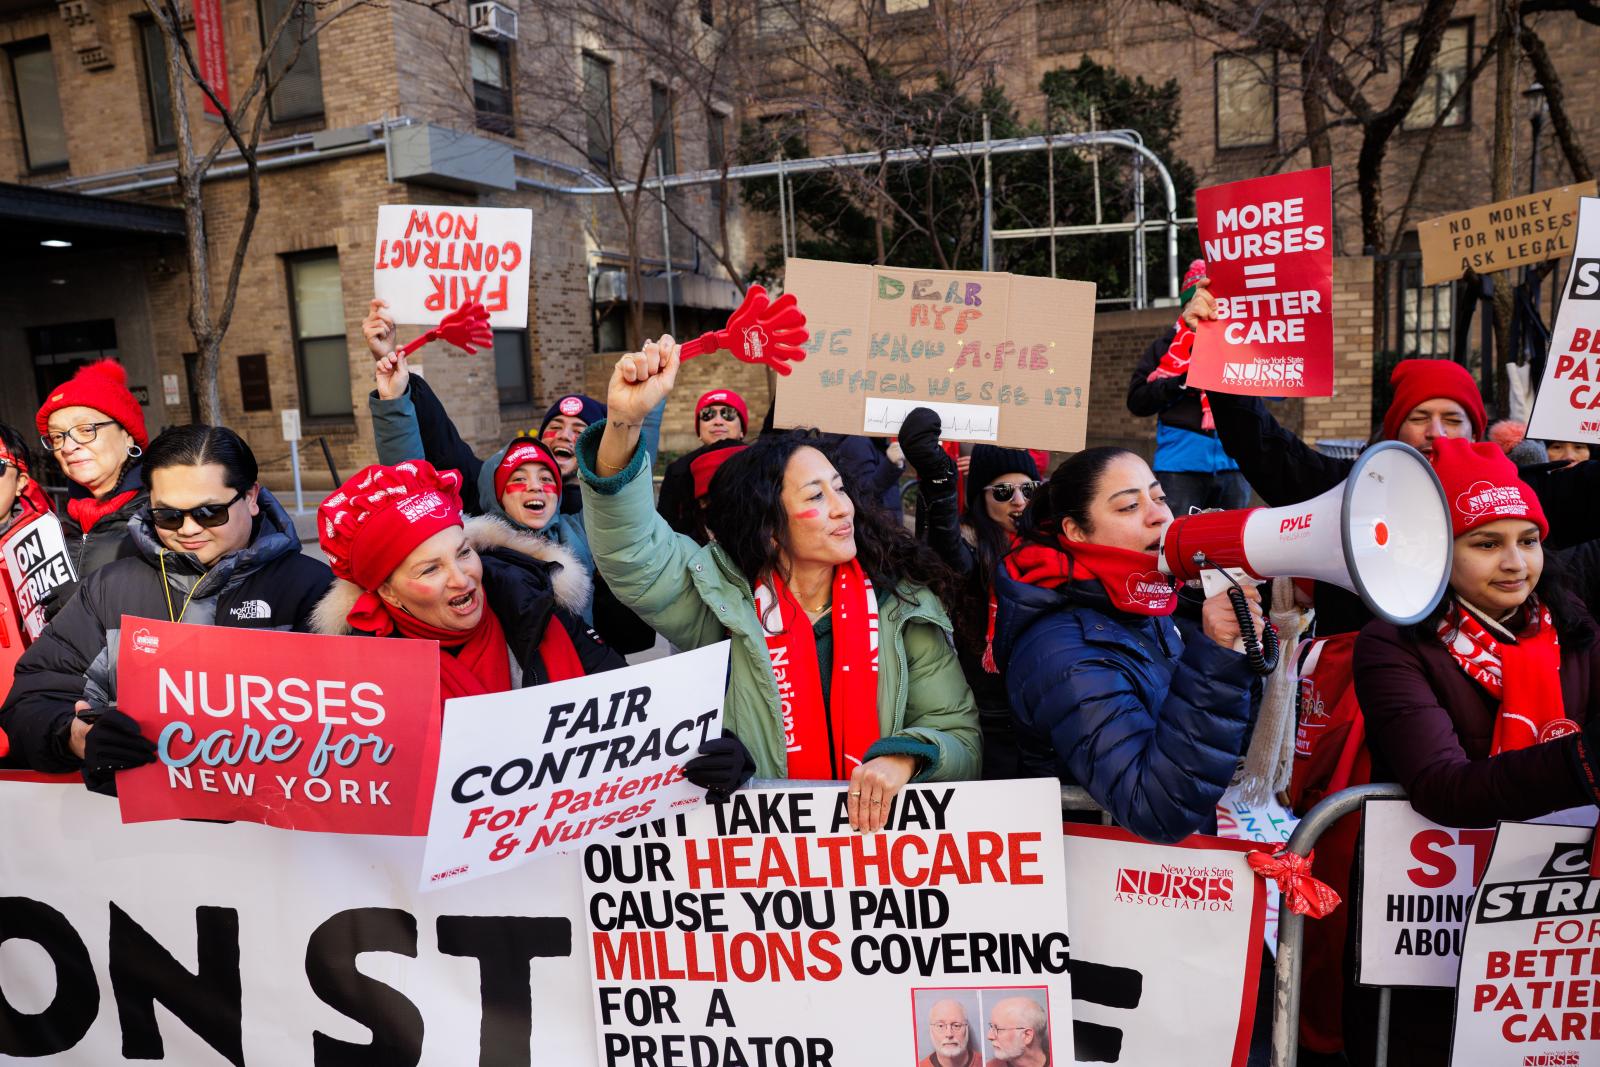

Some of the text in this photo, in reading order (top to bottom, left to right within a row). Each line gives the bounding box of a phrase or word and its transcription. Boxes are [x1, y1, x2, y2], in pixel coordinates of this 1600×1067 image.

[404, 209, 478, 240] NOW
[1216, 197, 1304, 234] MORE
[1449, 198, 1552, 234] NO MONEY
[1453, 213, 1572, 251] FOR NURSES
[376, 240, 522, 272] CONTRACT
[1204, 225, 1325, 263] NURSES
[1461, 236, 1569, 270] ASK LEGAL
[424, 274, 508, 311] FAIR
[876, 274, 982, 307] DEAR
[1216, 290, 1322, 320] BETTER
[909, 304, 983, 335] NYP
[1224, 318, 1305, 344] CARE
[869, 332, 945, 363] KNOW
[1271, 356, 1286, 364] York
[1287, 356, 1304, 364] State
[1221, 378, 1304, 388] ASSOCIATION
[1223, 363, 1304, 380] NURSES
[928, 377, 972, 401] WE
[980, 381, 1029, 406] SEE
[1044, 386, 1082, 408] IT!
[1468, 490, 1521, 508] NURSES
[1280, 513, 1312, 533] PYLE
[16, 534, 43, 573] ON
[18, 555, 71, 616] STRIKE
[229, 607, 257, 615] NORTH
[237, 613, 257, 621] FACE
[242, 600, 257, 608] THE
[159, 667, 386, 726] NURSES
[768, 646, 802, 753] National
[542, 686, 652, 744] FAIR
[157, 721, 395, 778] Care for
[1551, 727, 1565, 738] Fair
[450, 708, 718, 804] CONTRACT
[167, 765, 392, 806] NEW YORK
[462, 762, 688, 840] For Patients
[488, 833, 520, 862] &
[524, 797, 657, 854] Nurses
[706, 792, 817, 836] TAKE
[583, 832, 1044, 889] OUR HEALTHCARE
[1161, 863, 1234, 877] New York State
[1406, 829, 1498, 889] ST
[1114, 892, 1234, 912] ASSOCIATION
[1116, 868, 1234, 902] NURSES
[1483, 879, 1600, 919] STRI
[589, 888, 950, 933] CAUSE YOU PAID
[593, 930, 1070, 983] MILLIONS COVERING
[1486, 948, 1600, 980] BETT
[0, 896, 246, 1067] ON
[1473, 980, 1600, 1013] PATIE
[599, 985, 737, 1028] FOR A
[604, 1033, 834, 1067] PREDATOR
[1522, 1055, 1580, 1067] NURSES
